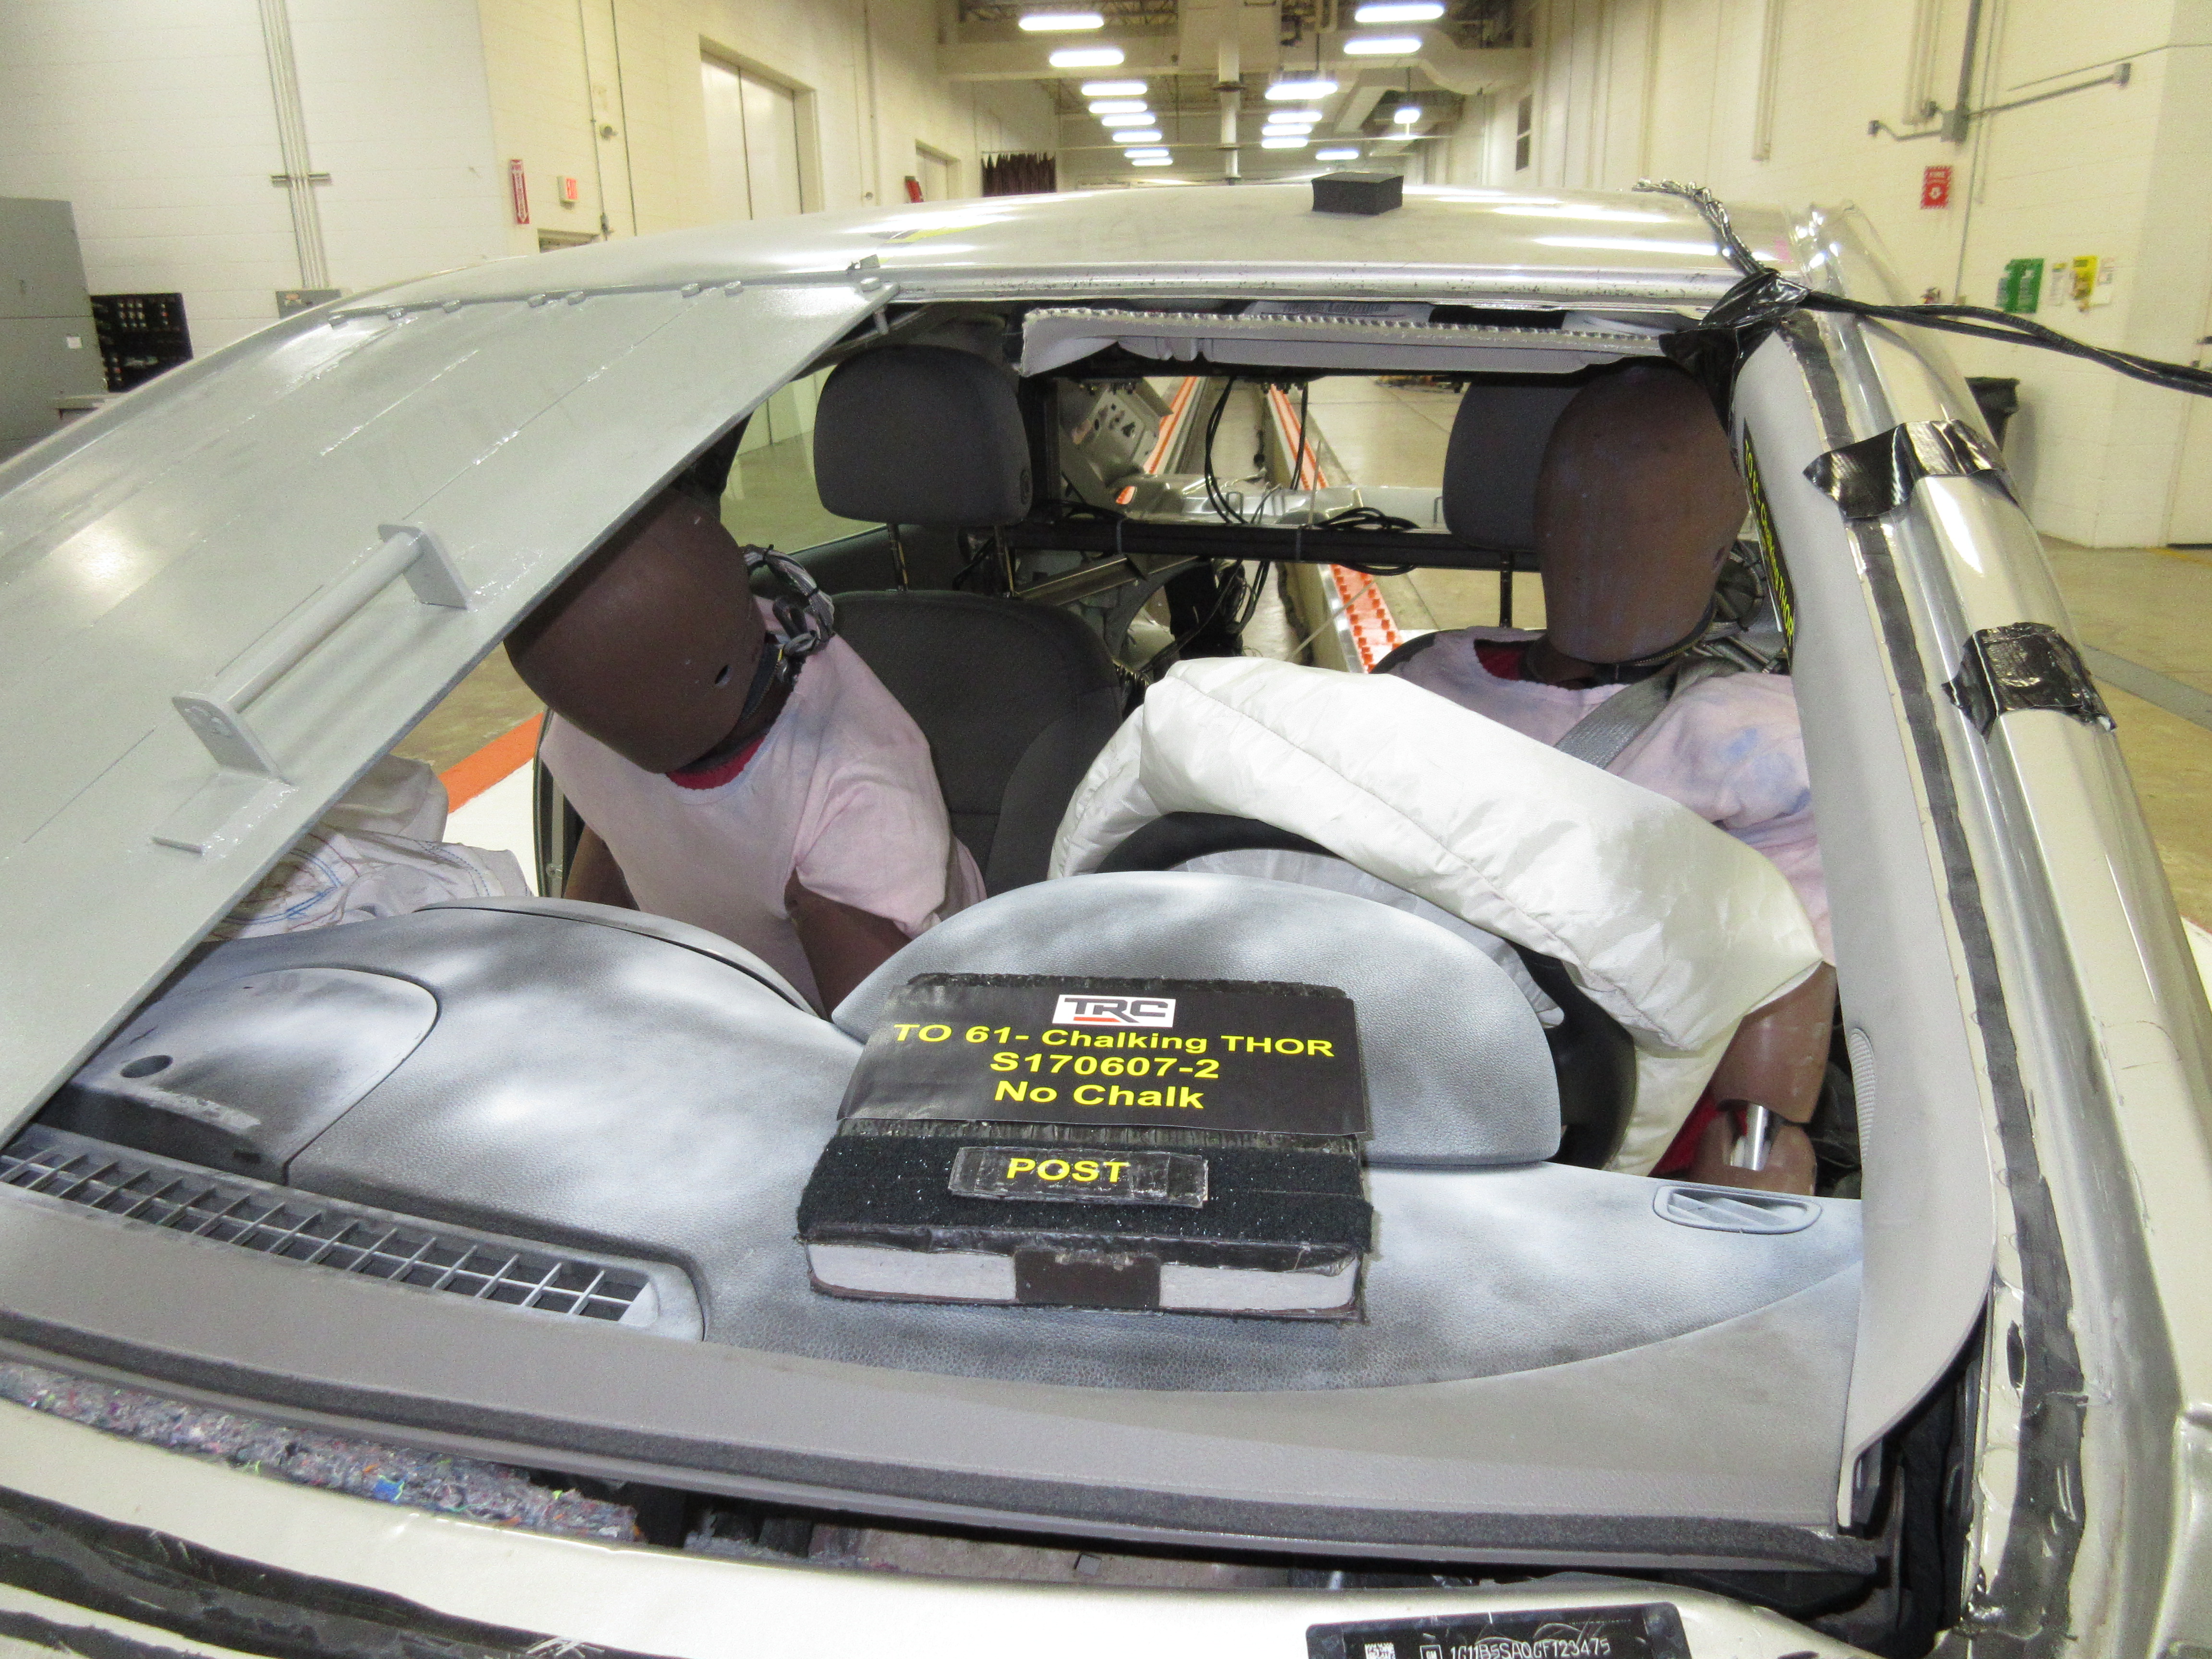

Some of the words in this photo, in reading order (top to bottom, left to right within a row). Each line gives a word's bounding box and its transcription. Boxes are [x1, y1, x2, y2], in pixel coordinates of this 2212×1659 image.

[1064, 997, 1168, 1023] TRC
[895, 1024, 953, 1043] TO
[965, 1026, 1030, 1045] 61-
[1041, 1029, 1208, 1055] Chalking
[1221, 1035, 1335, 1058] THOR
[990, 1051, 1220, 1080] S170607-2
[994, 1080, 1058, 1104] No
[1073, 1084, 1205, 1110] Chalk
[1006, 1157, 1130, 1184] POST
